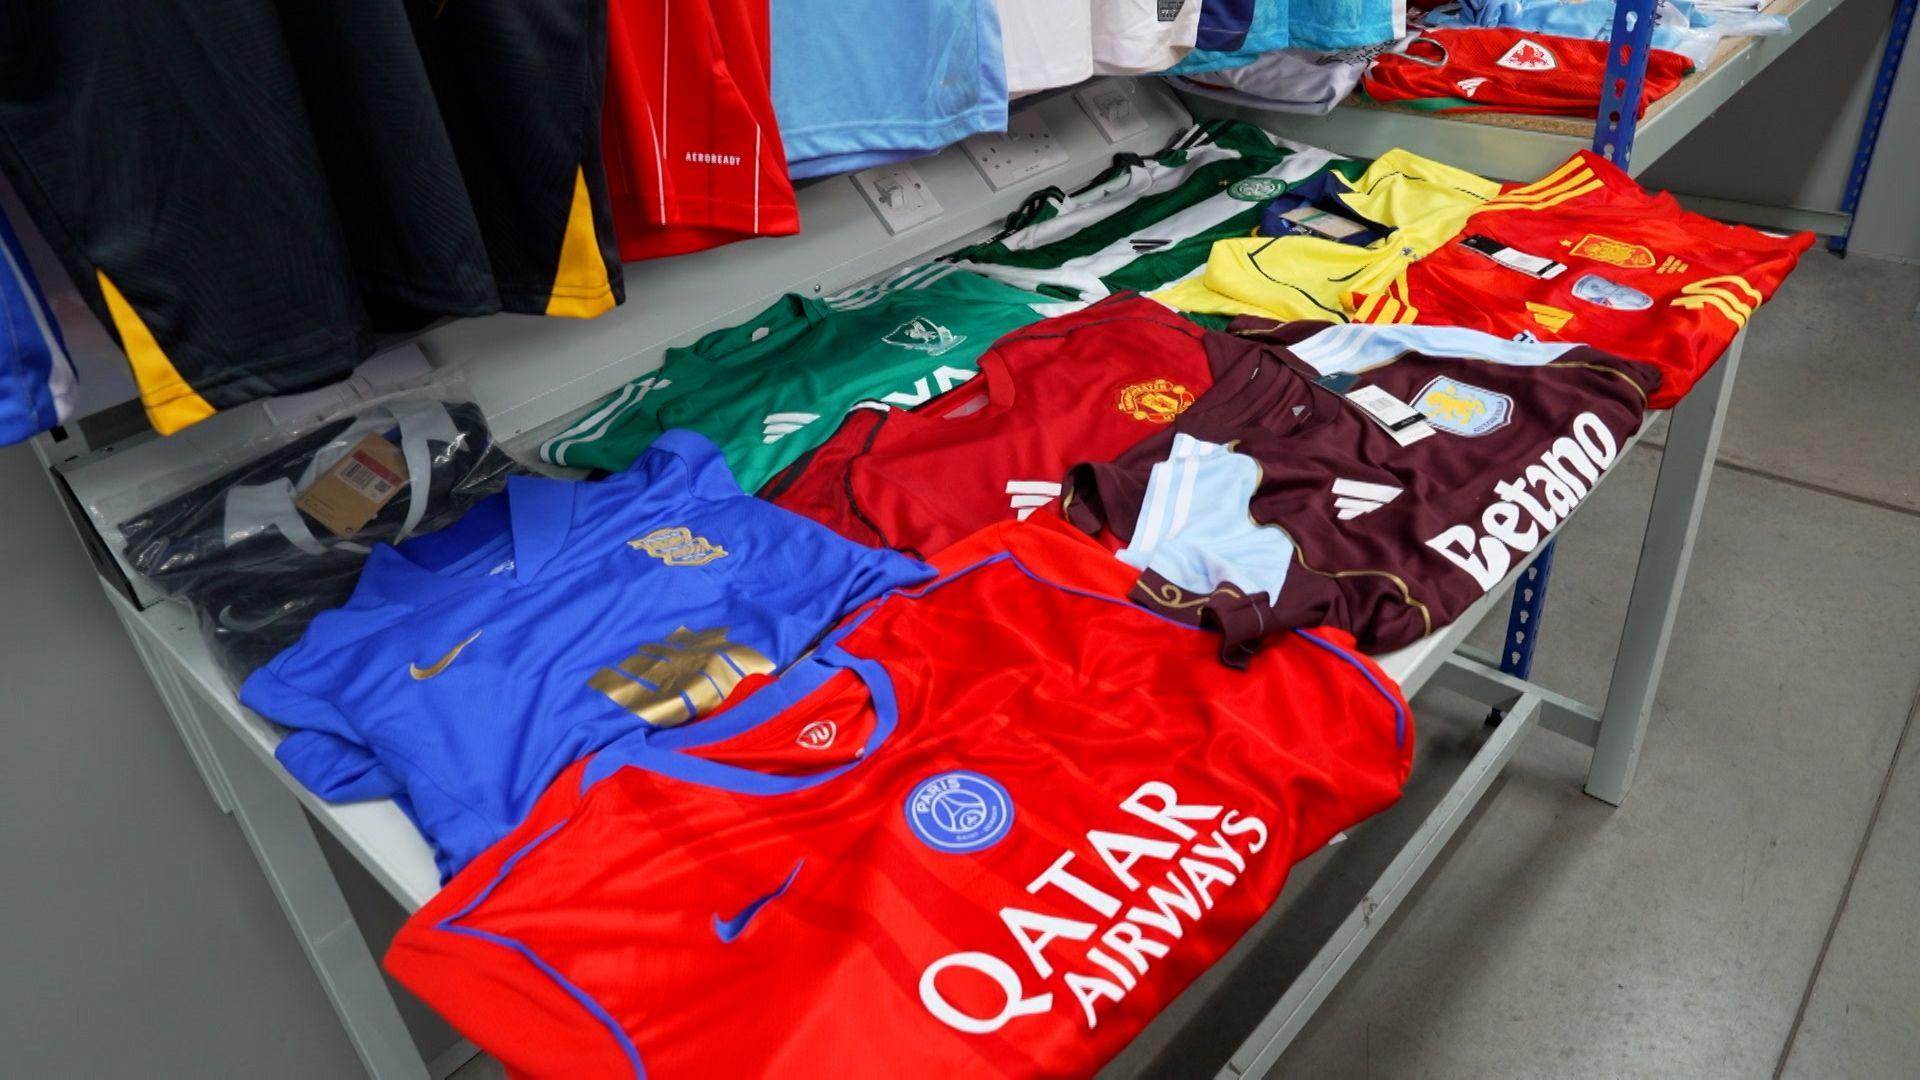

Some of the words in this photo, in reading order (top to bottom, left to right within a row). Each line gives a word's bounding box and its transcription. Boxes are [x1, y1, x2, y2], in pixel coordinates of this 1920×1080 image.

[685, 152, 741, 166] AEROREADY
[1426, 411, 1617, 592] Betano
[916, 778, 960, 812] PARIS
[919, 781, 1224, 1034] QATAR
[1064, 809, 1268, 1030] AIRWAYS
